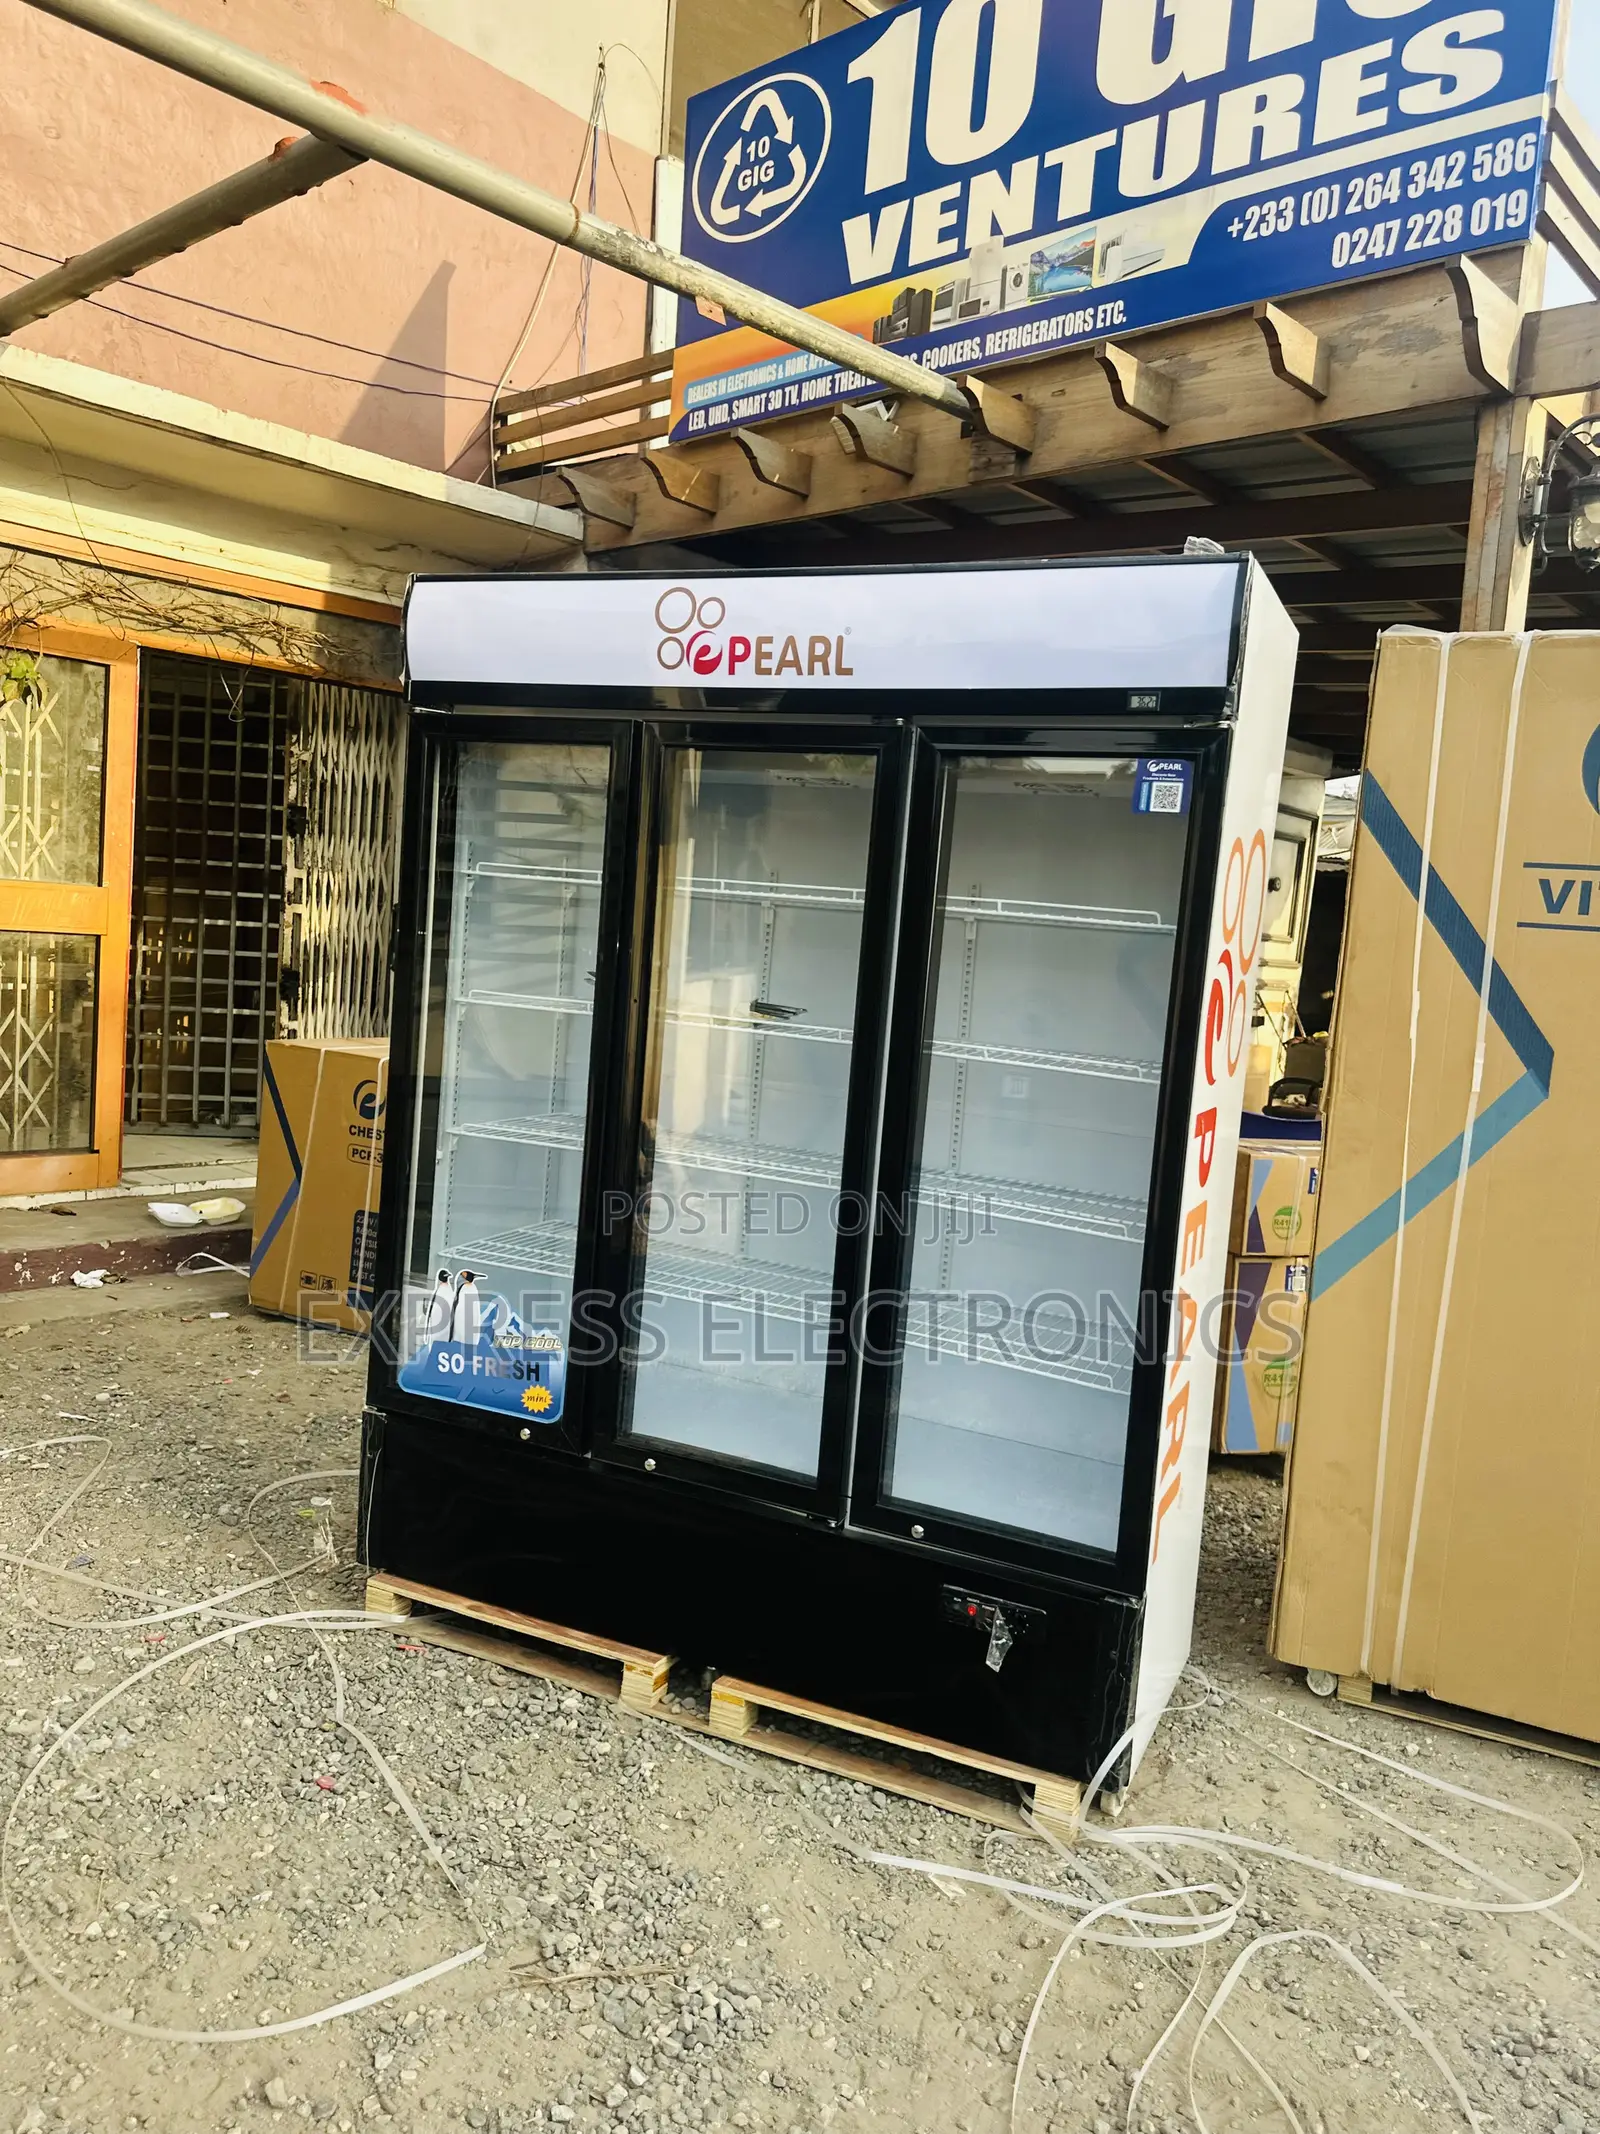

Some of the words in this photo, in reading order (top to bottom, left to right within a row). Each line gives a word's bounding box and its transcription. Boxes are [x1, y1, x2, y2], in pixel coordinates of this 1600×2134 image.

[847, 0, 1042, 196] 10
[746, 135, 770, 162] 10
[841, 10, 1504, 284] VENTURES
[737, 159, 775, 191] GIG
[1227, 196, 1295, 242] +233
[1346, 168, 1401, 217] 264
[1407, 150, 1463, 201] 342
[1472, 132, 1537, 184] 586
[1331, 219, 1402, 269] 0247
[1404, 203, 1463, 252] 228
[1470, 189, 1529, 238] 019
[922, 337, 982, 370] COOKERS,
[984, 305, 1094, 358] REFRIGERATORS
[1096, 300, 1127, 329] ETC.
[687, 380, 718, 404] DEALERS
[718, 377, 727, 396] IN
[727, 363, 777, 394] ELECTRONICS
[778, 363, 784, 380] &
[785, 354, 809, 377] HOME
[688, 409, 707, 432] LED,
[708, 403, 730, 427] UHD,
[731, 392, 767, 421] SMART
[768, 388, 783, 411] 3D
[784, 383, 800, 408] TV,
[801, 374, 833, 401] HOME
[1158, 762, 1183, 771] PEARL
[1538, 878, 1600, 917] VI
[492, 1334, 521, 1348] TOP
[524, 1336, 563, 1351] COOL
[1152, 1106, 1218, 1566] PEARL
[437, 1351, 464, 1375] SO
[472, 1355, 540, 1383] FRESH
[526, 1393, 547, 1404] mini
